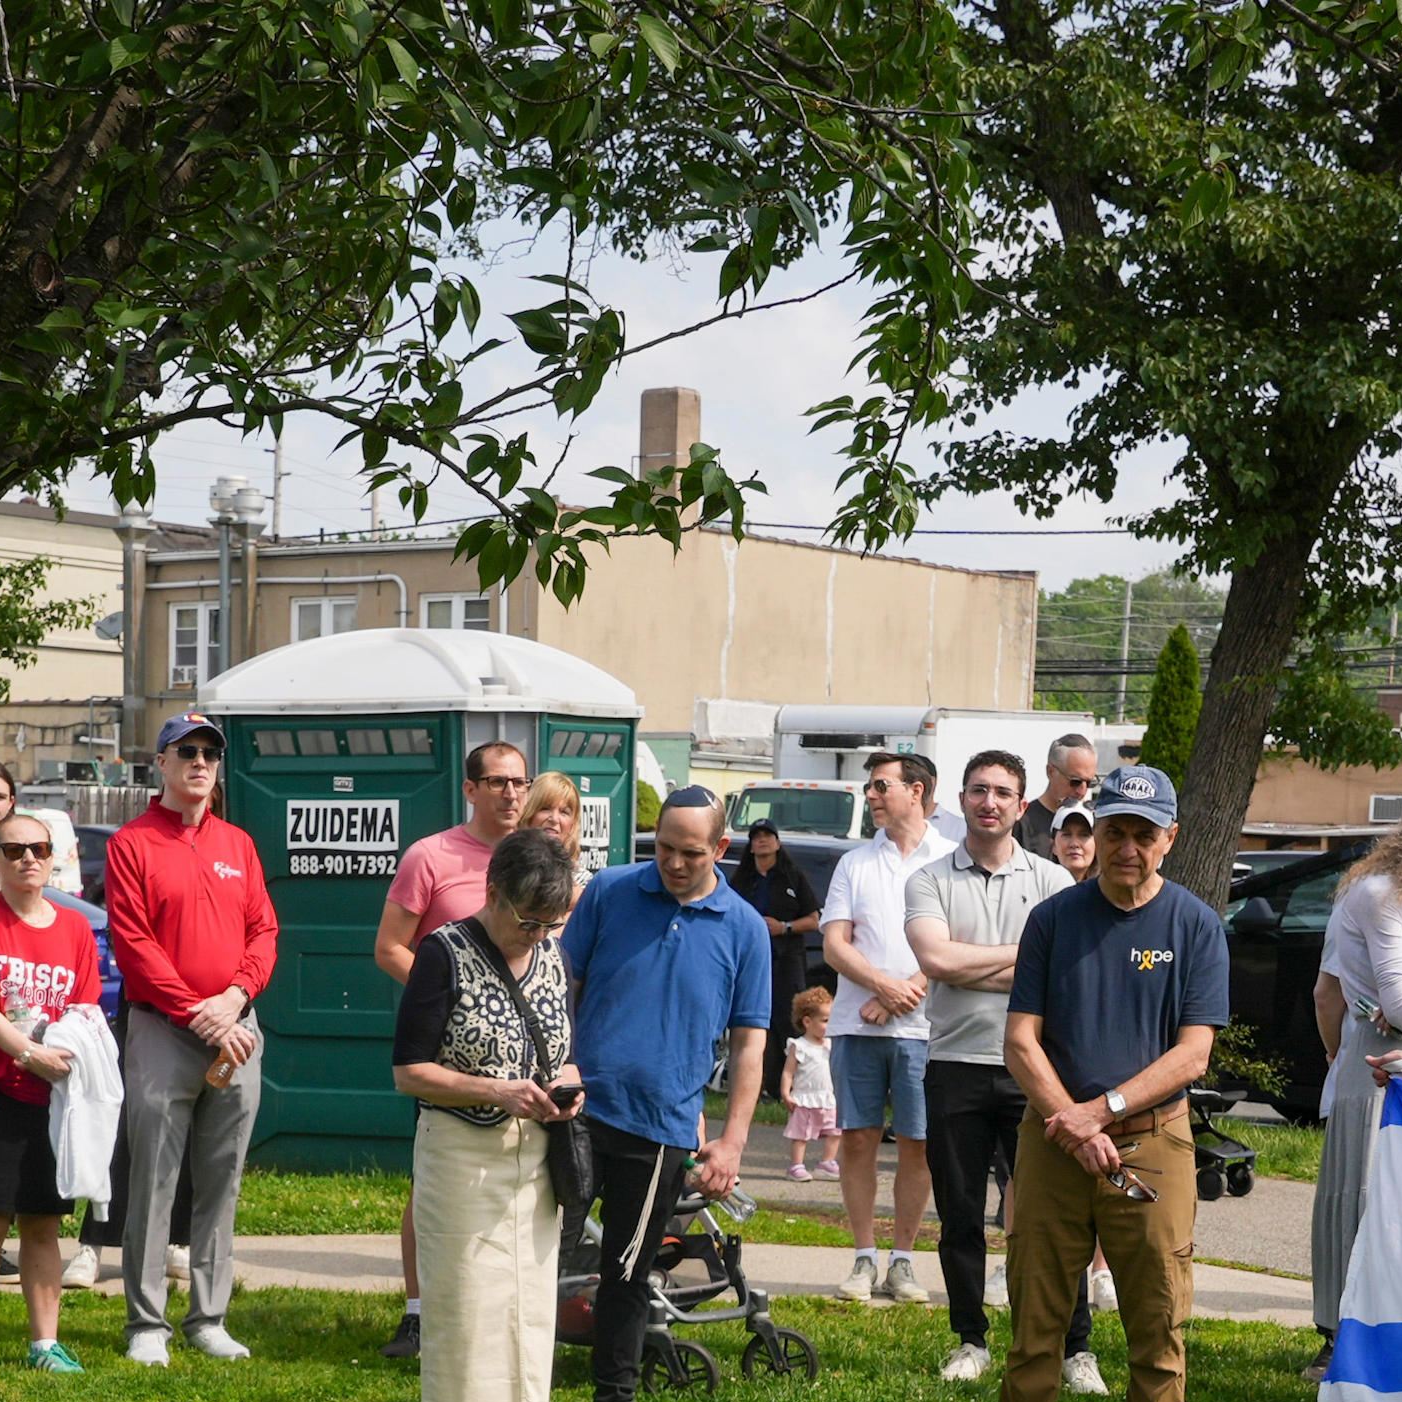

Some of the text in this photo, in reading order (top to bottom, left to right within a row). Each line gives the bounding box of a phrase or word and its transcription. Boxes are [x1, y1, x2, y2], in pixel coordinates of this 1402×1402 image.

[290, 807, 396, 843] ZUIDEMA
[582, 805, 609, 838] DEMA
[290, 855, 397, 876] 888-901-7392
[0, 979, 67, 1012] SRONG
